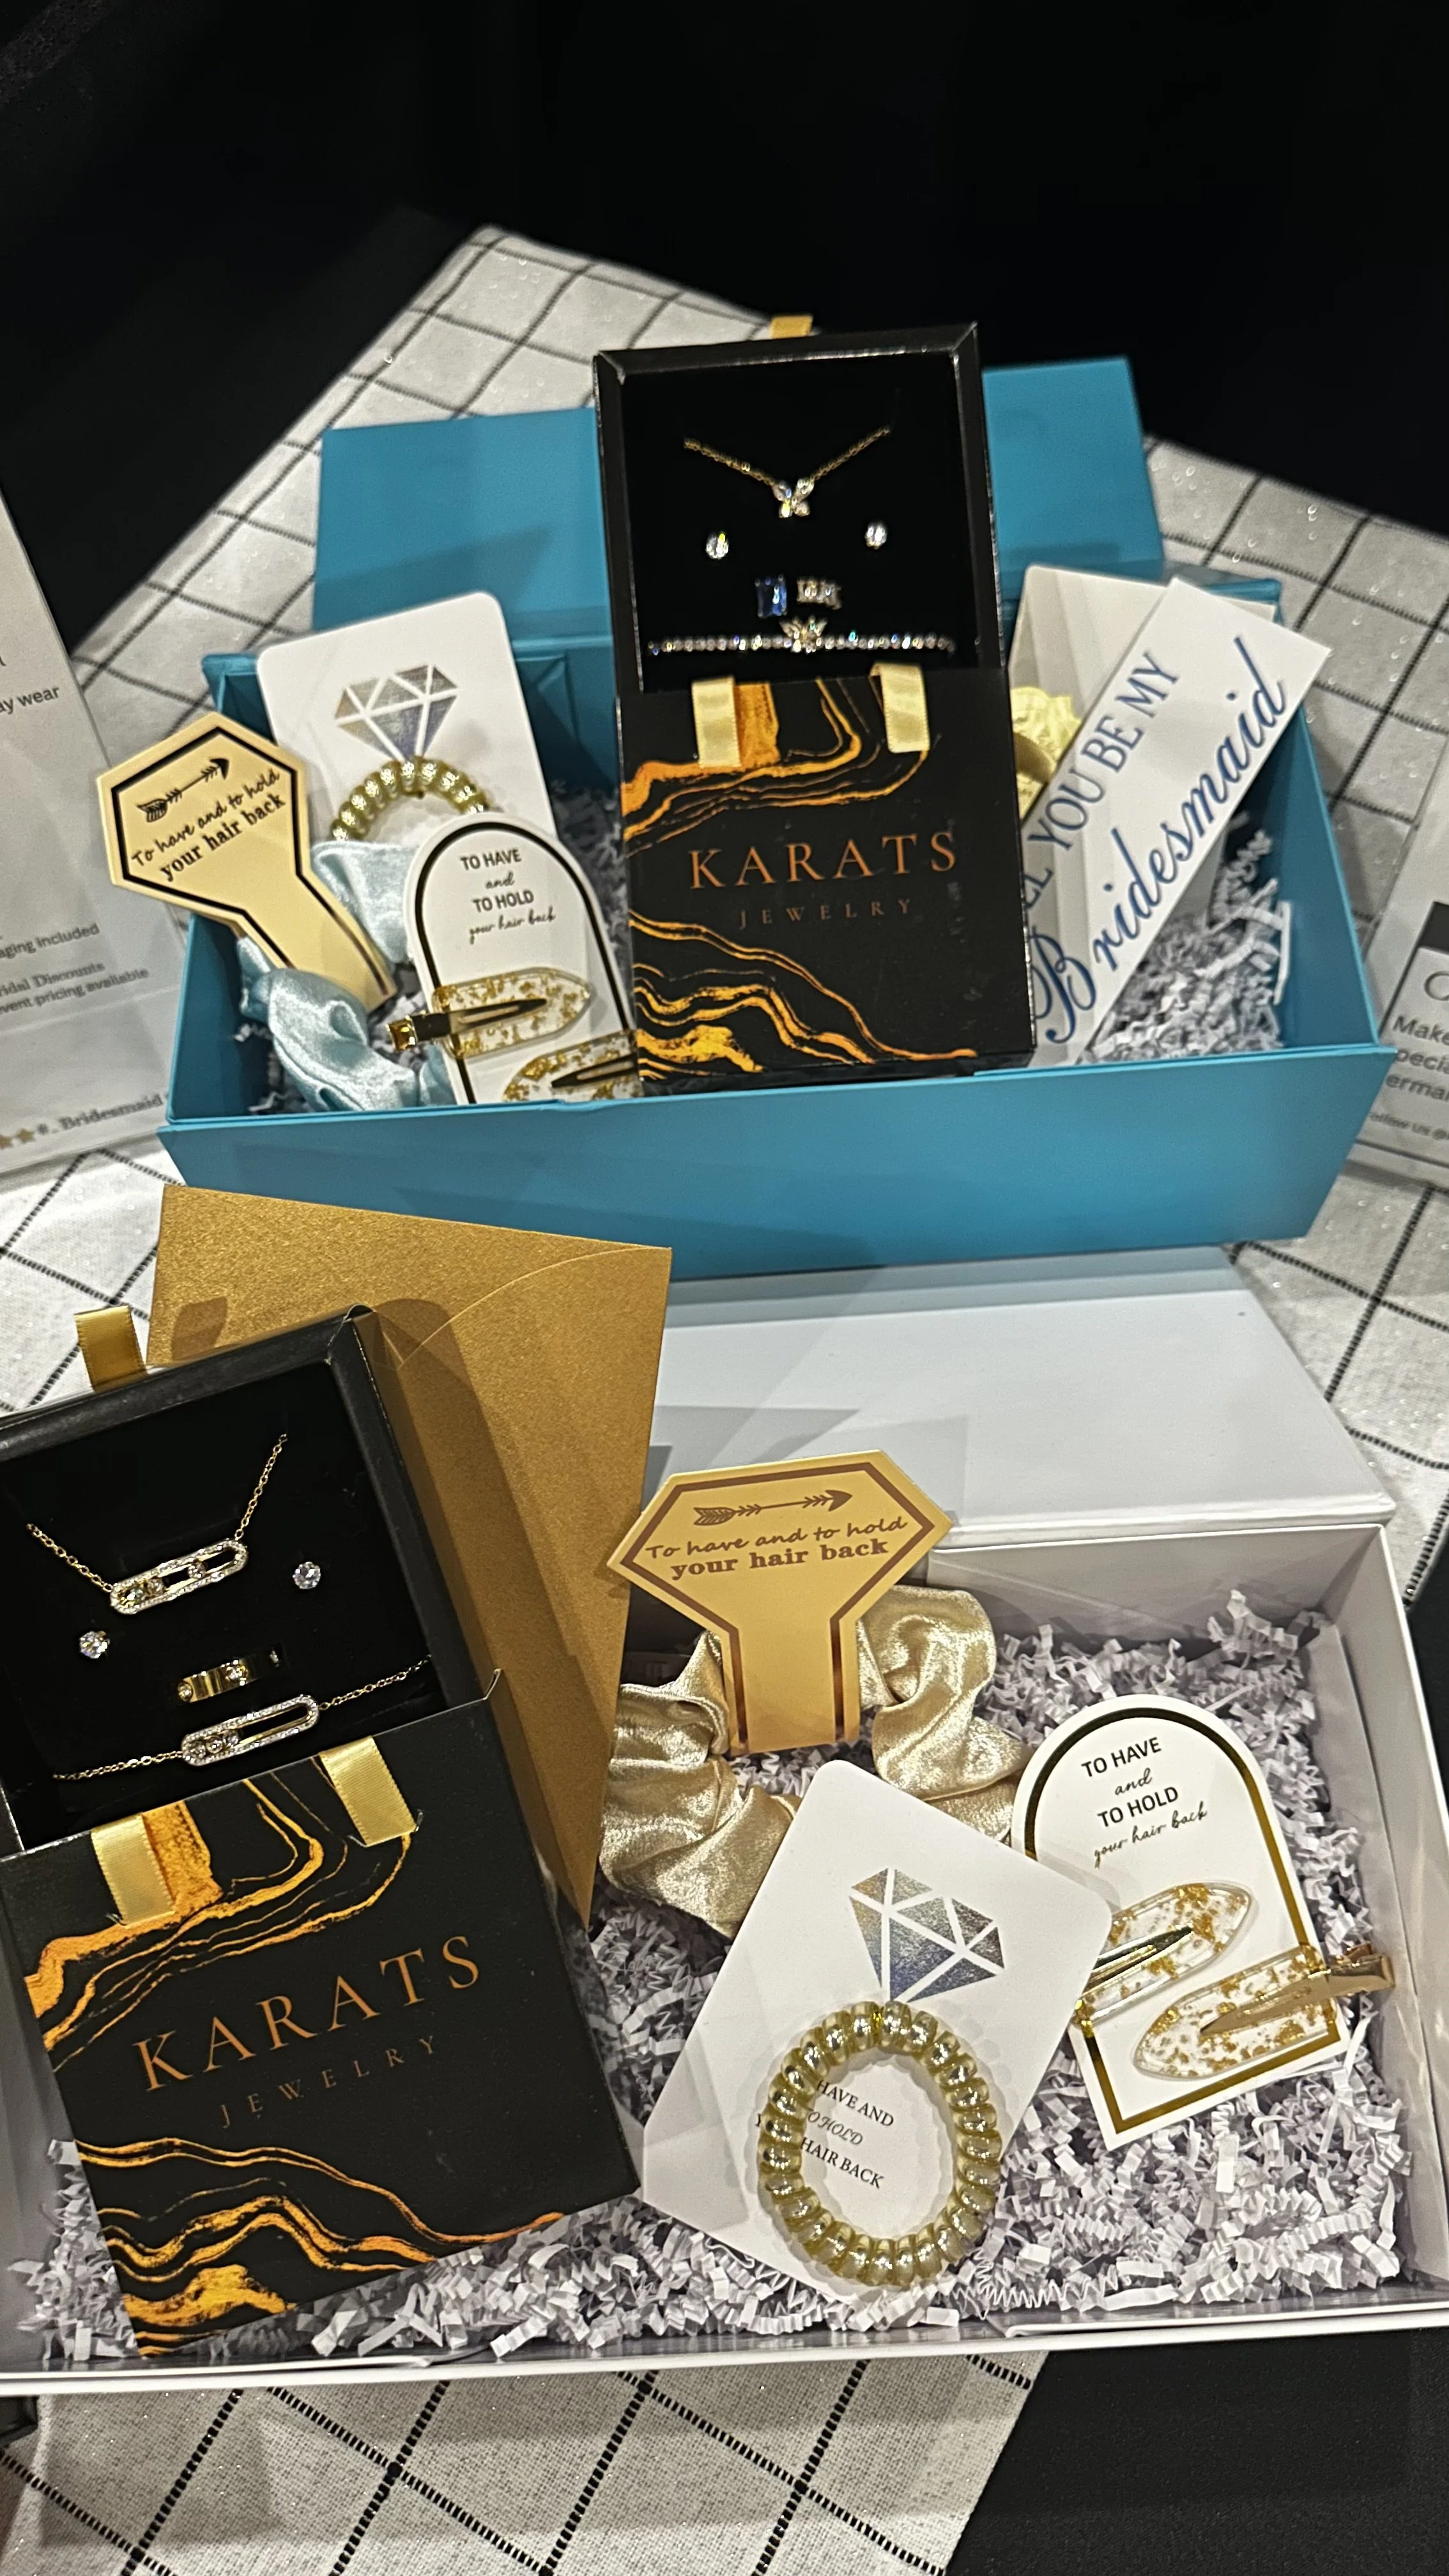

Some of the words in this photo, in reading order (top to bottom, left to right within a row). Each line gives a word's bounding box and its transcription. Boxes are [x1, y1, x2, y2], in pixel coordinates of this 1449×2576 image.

[17, 687, 59, 707] wear
[1027, 771, 1105, 851] YOU
[1082, 716, 1144, 774] BE
[1126, 652, 1180, 720] MY
[132, 850, 154, 866] To
[155, 825, 195, 853] have
[198, 801, 227, 827] and
[229, 793, 243, 809] to
[243, 768, 280, 798] hold
[160, 845, 204, 882] your
[203, 821, 242, 851] hair
[241, 793, 286, 825] back
[461, 855, 481, 871] TO
[483, 848, 522, 867] HAVE
[689, 832, 956, 889] KARATS
[1030, 637, 1287, 1044] Bridesmaid
[486, 872, 515, 889] and
[472, 897, 493, 914] TO
[494, 889, 534, 909] HOLD
[739, 899, 910, 931] JEWELRY
[36, 923, 100, 948] included
[468, 922, 495, 944] your
[498, 915, 526, 931] hair
[528, 907, 556, 924] back
[32, 962, 105, 988] Discounts
[34, 985, 86, 1007] pricing
[86, 969, 149, 992] available
[58, 1093, 164, 1130] Bridesmaid
[645, 1545, 678, 1560] To
[687, 1537, 749, 1556] have
[755, 1529, 808, 1547] and
[813, 1525, 841, 1540] to
[847, 1516, 908, 1538] hold
[670, 1556, 739, 1581] your
[749, 1547, 809, 1569] hair
[820, 1538, 889, 1561] back
[1081, 1757, 1107, 1777] TO
[1110, 1736, 1162, 1768] HAVE
[1114, 1767, 1153, 1795] and
[1097, 1807, 1124, 1827] TO
[1126, 1786, 1179, 1817] HOLD
[1094, 1839, 1128, 1869] your
[1131, 1825, 1167, 1843] hair
[1171, 1800, 1208, 1828] back
[132, 1935, 480, 2092] KARATS
[220, 2035, 438, 2128] JEWELRY
[816, 2079, 859, 2108] HAVE
[857, 2103, 894, 2128] AND
[817, 2114, 863, 2145] HOLD
[801, 2137, 839, 2166] HAIR
[839, 2157, 885, 2189] BACK
